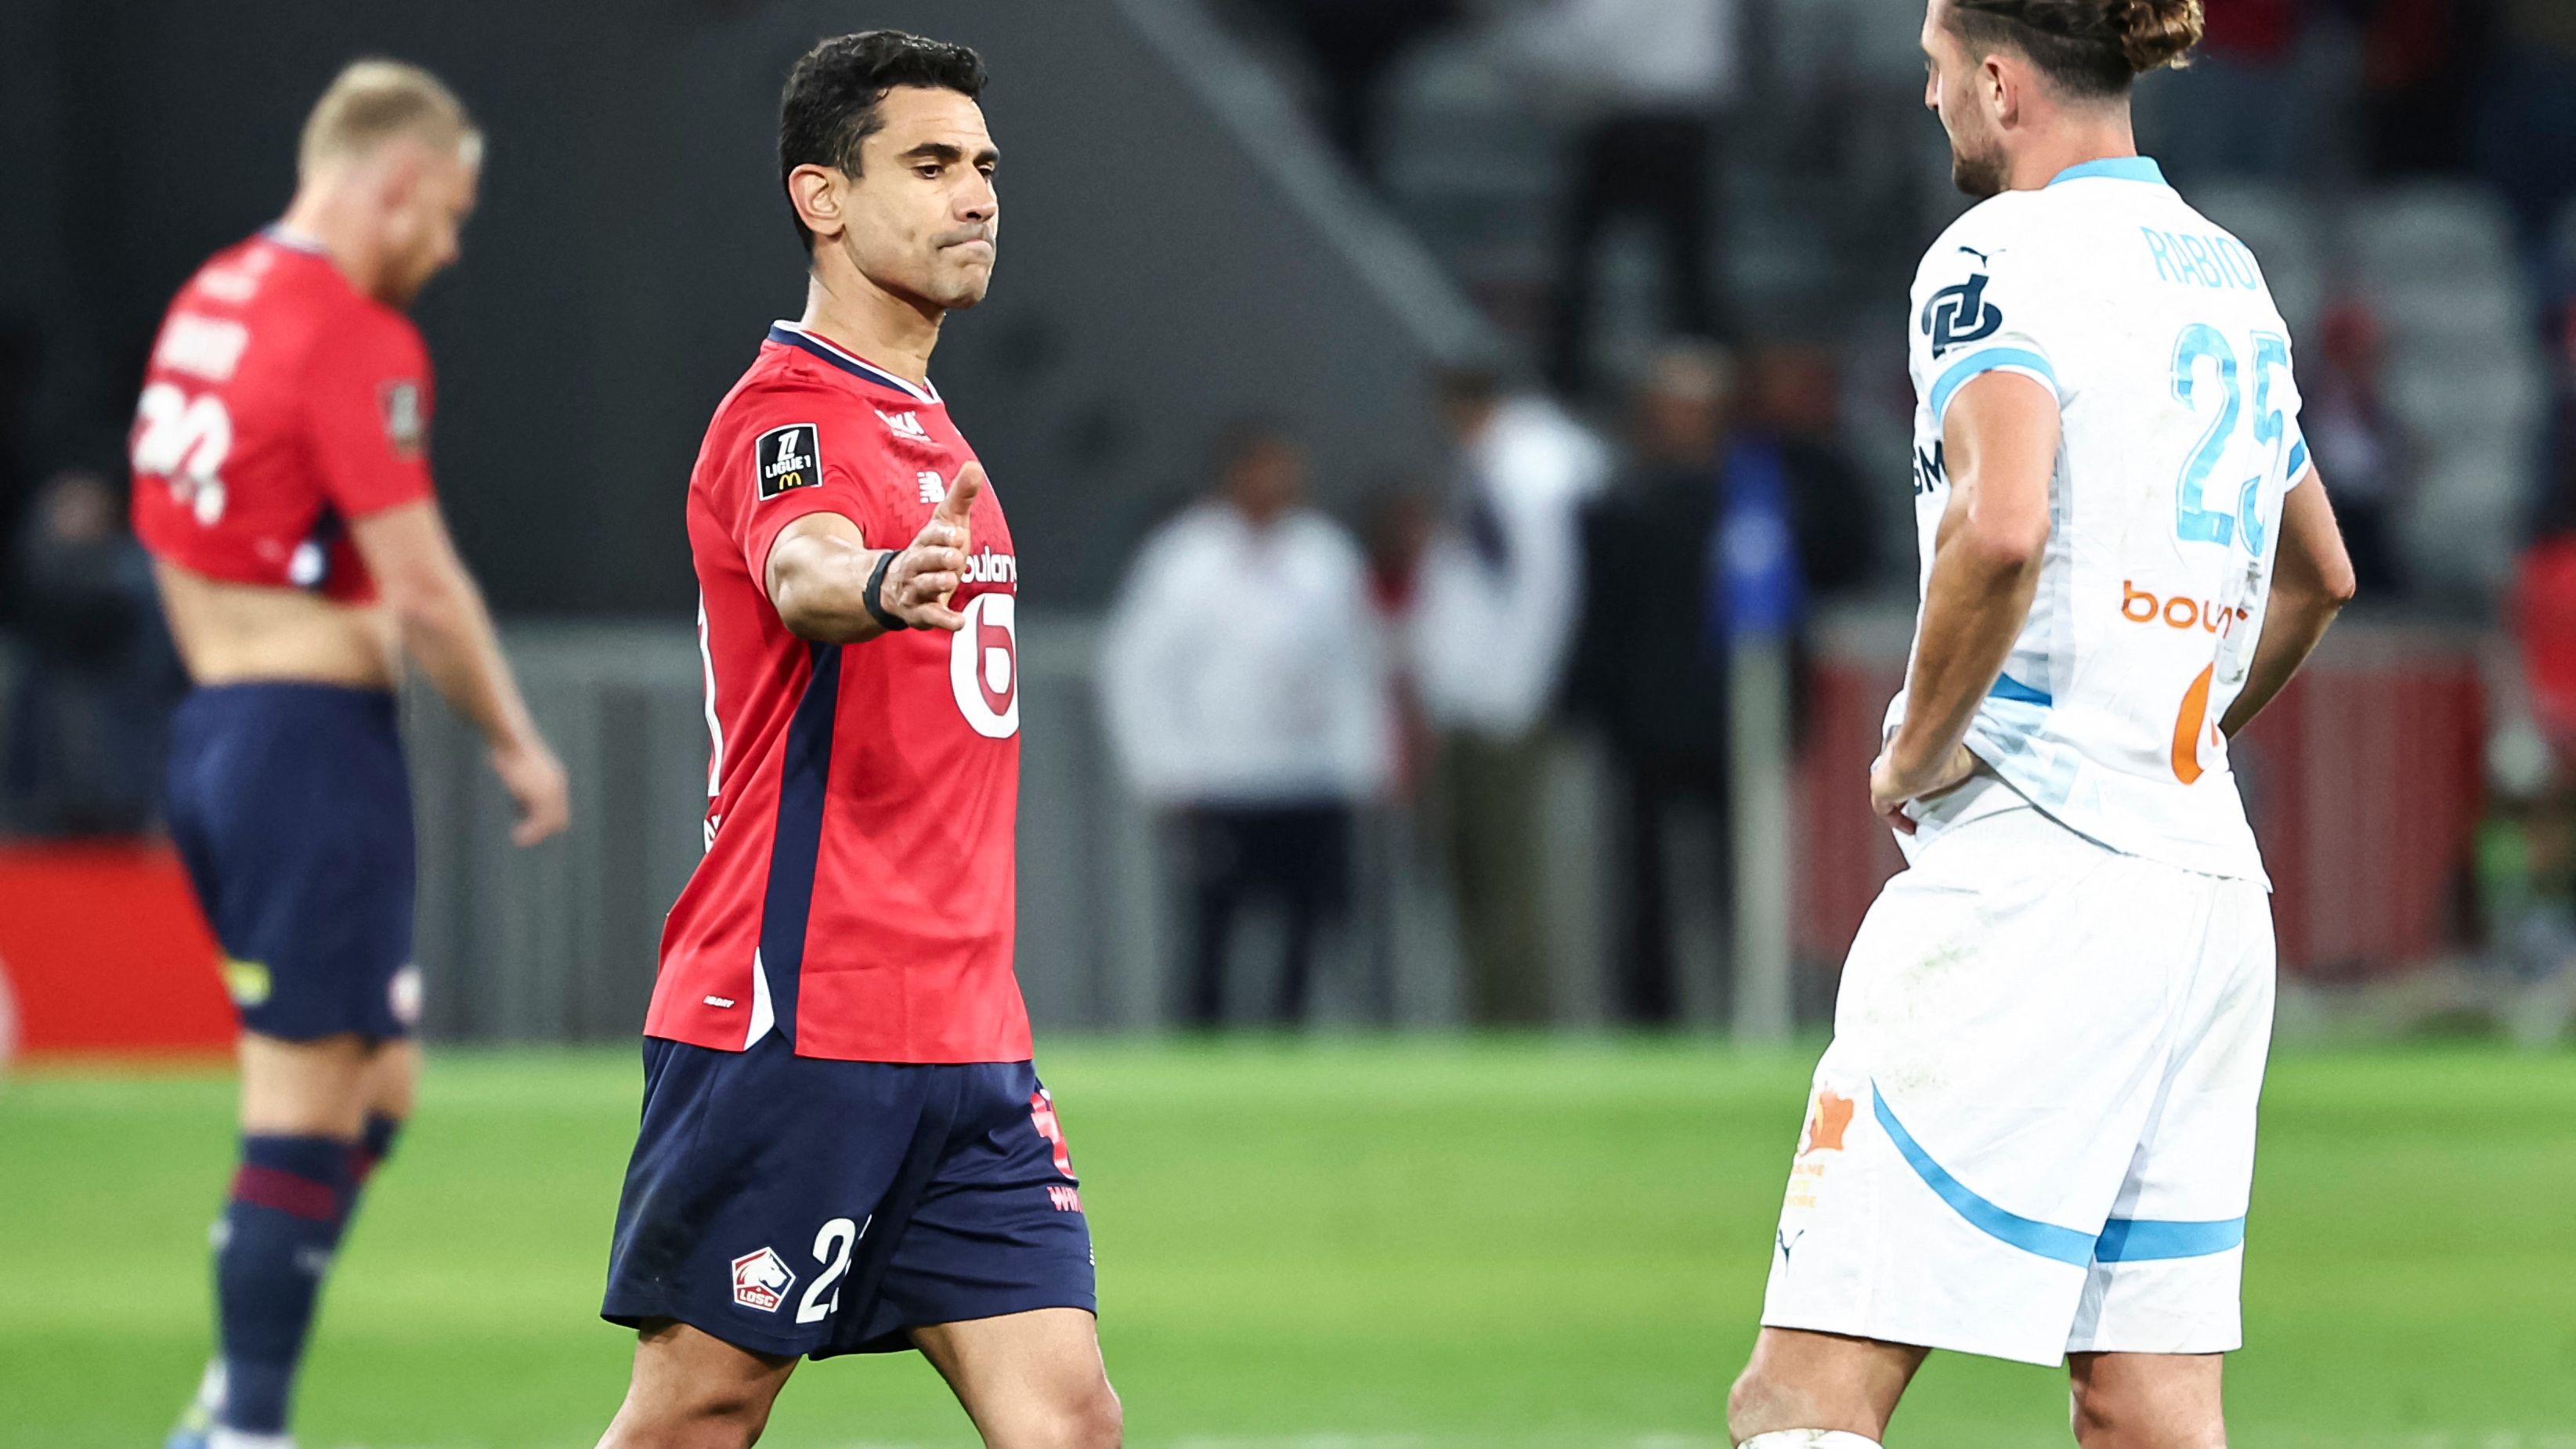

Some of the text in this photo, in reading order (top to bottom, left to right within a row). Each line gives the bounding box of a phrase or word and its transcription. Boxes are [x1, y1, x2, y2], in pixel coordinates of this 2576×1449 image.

[2140, 226, 2262, 290] RABIO
[765, 454, 811, 479] LIGUE 1
[2170, 323, 2287, 558] 25
[739, 1288, 775, 1308] LOSC
[796, 1214, 872, 1324] 2
